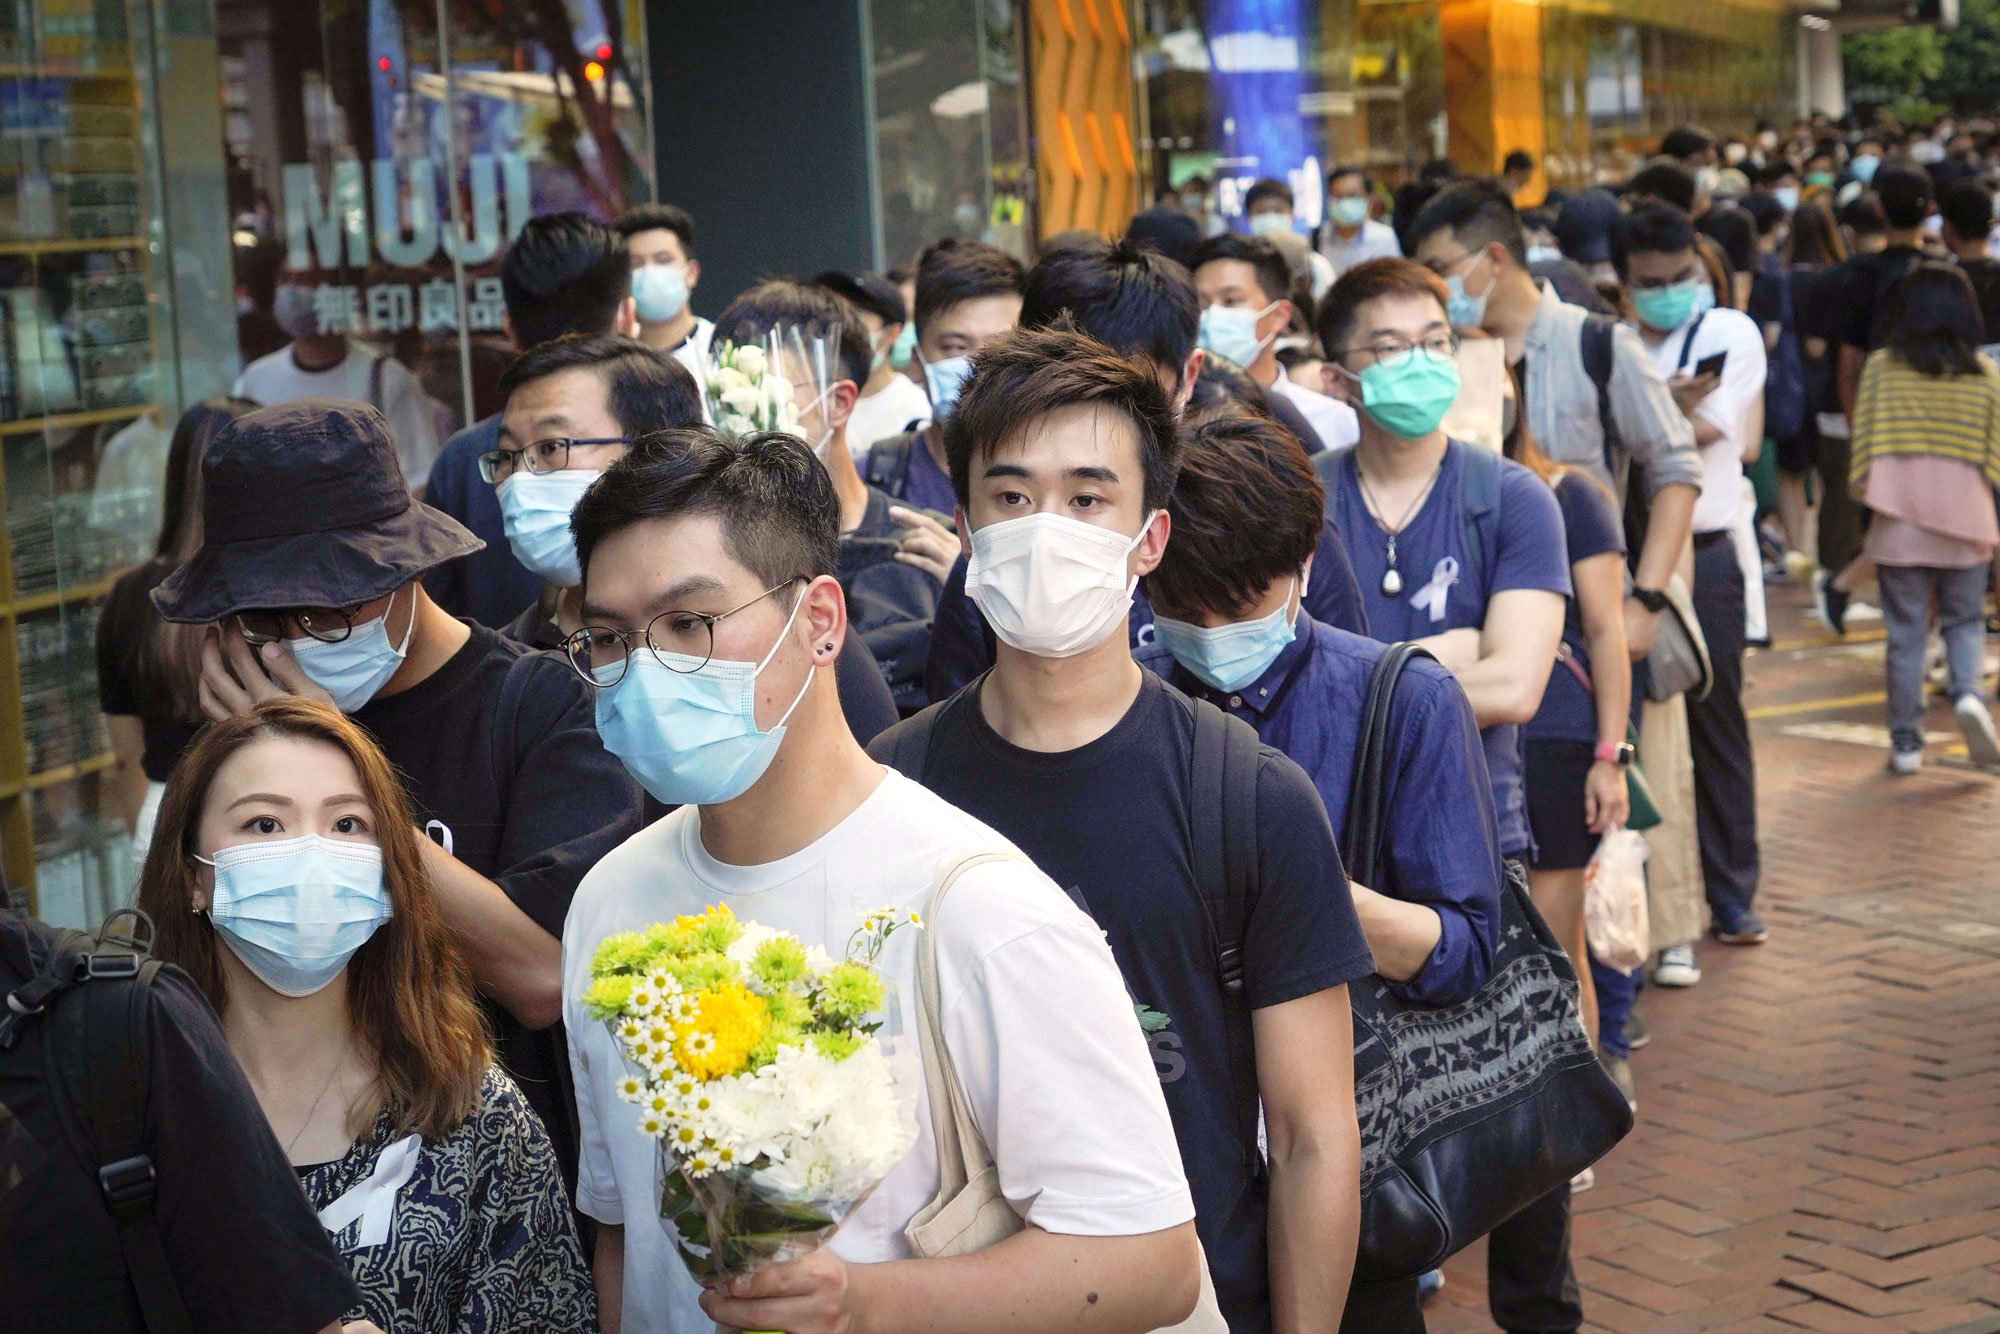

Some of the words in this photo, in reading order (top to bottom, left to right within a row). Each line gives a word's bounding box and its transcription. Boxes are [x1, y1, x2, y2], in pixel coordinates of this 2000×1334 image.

[282, 153, 531, 271] MUJI
[314, 276, 505, 335] 無印良品
